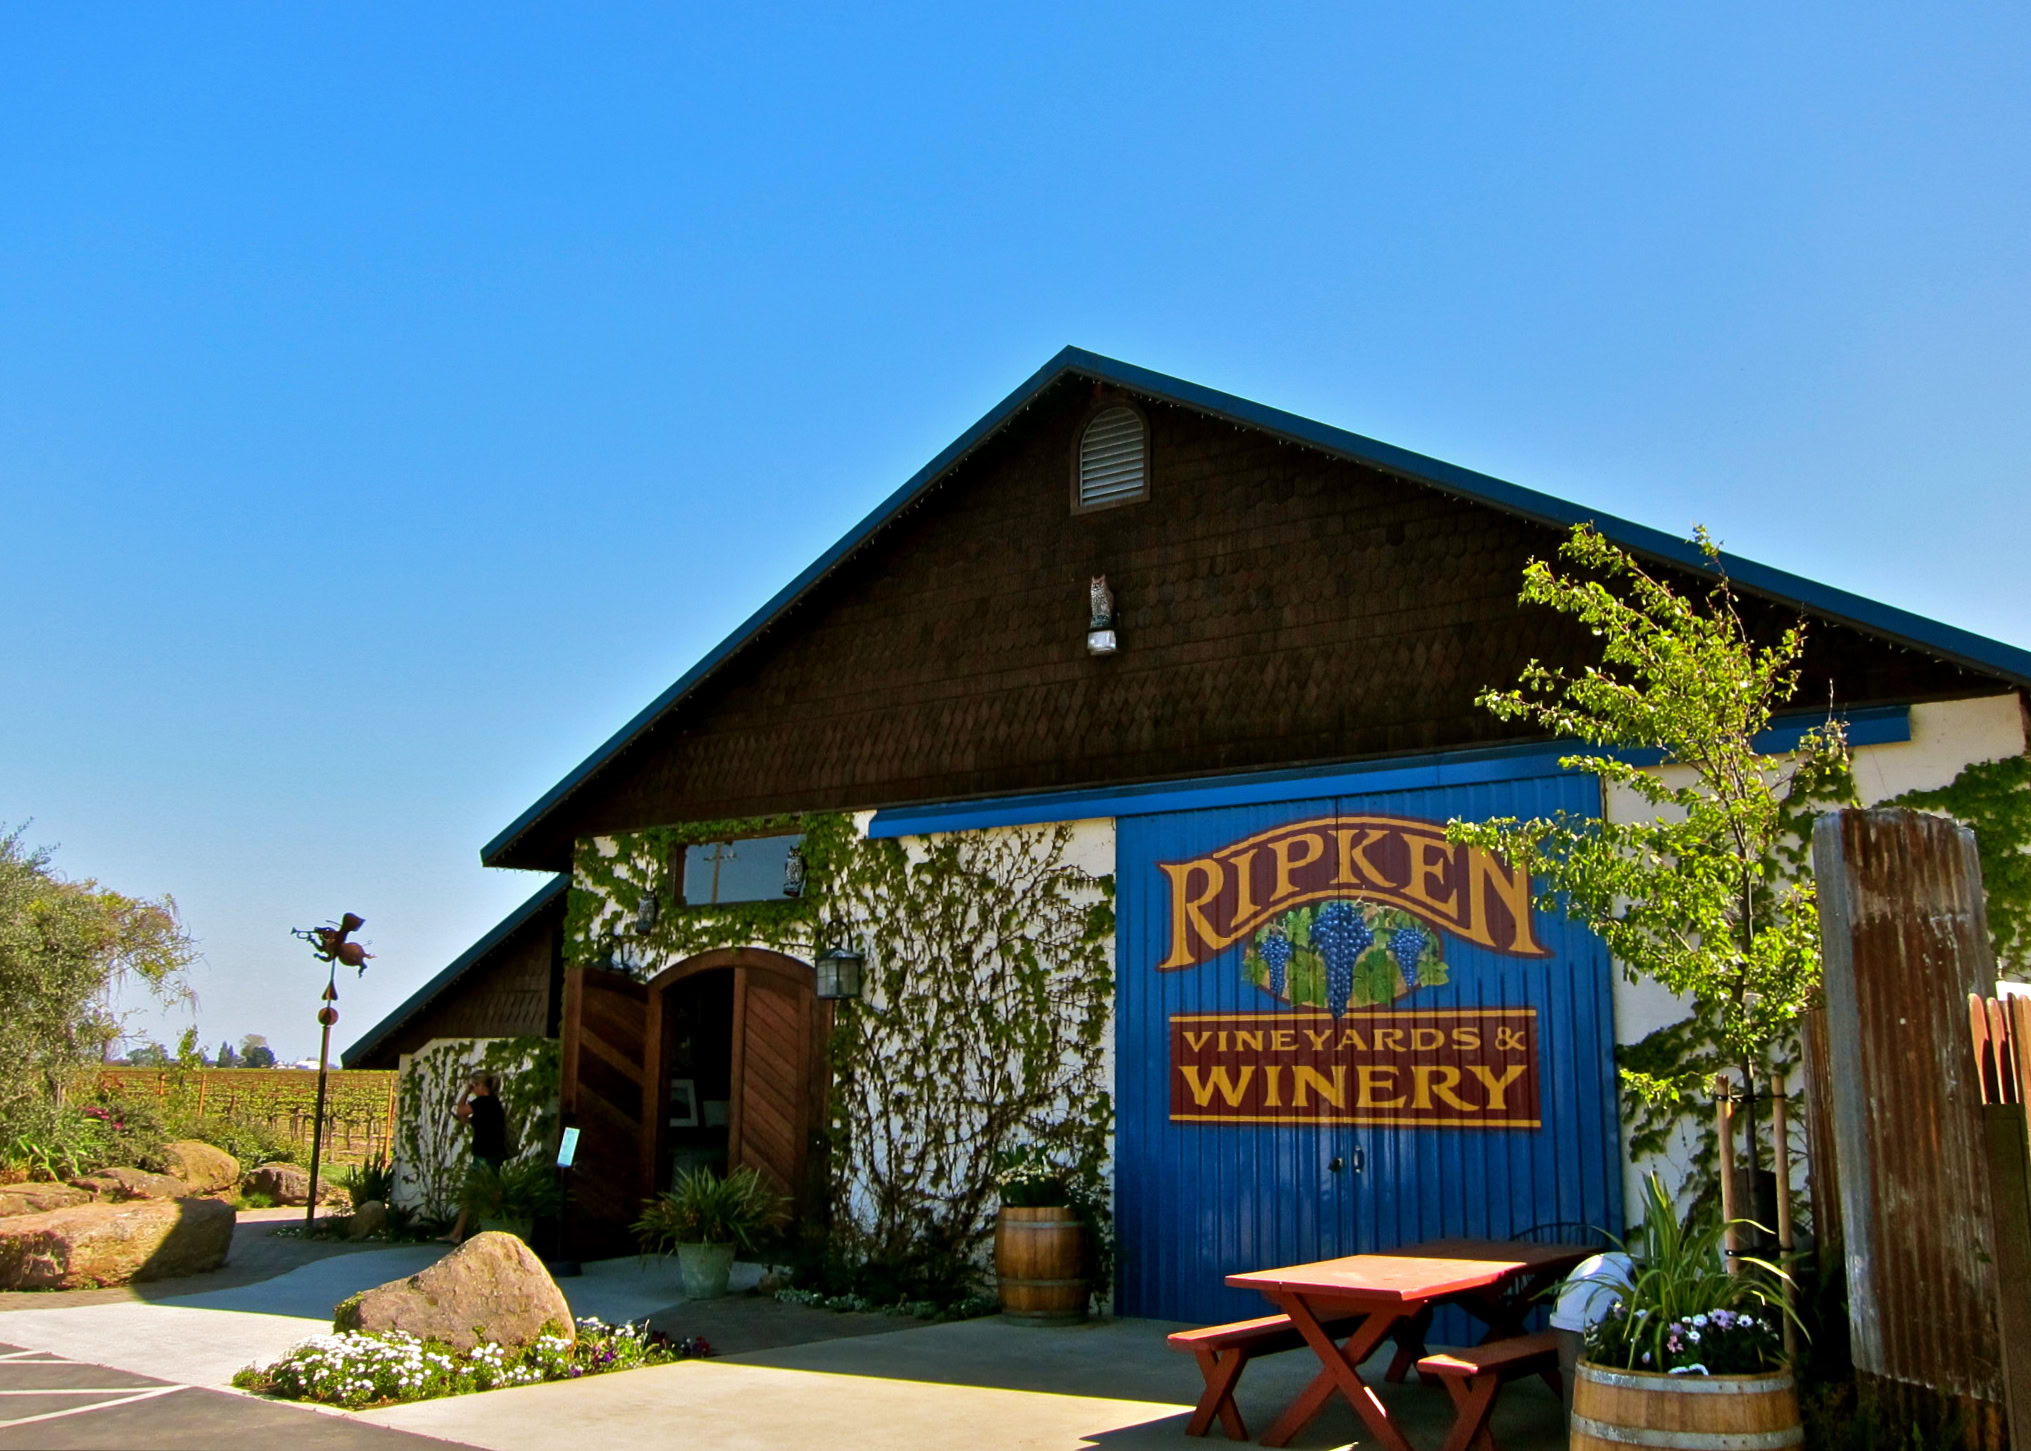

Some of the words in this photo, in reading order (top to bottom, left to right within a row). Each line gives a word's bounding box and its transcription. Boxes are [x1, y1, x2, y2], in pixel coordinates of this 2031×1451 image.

[1159, 828, 1545, 968] RIPKEN
[1182, 1028, 1481, 1053] VINEYARDS
[1495, 1026, 1527, 1050] &
[1179, 1065, 1527, 1112] WINERY
